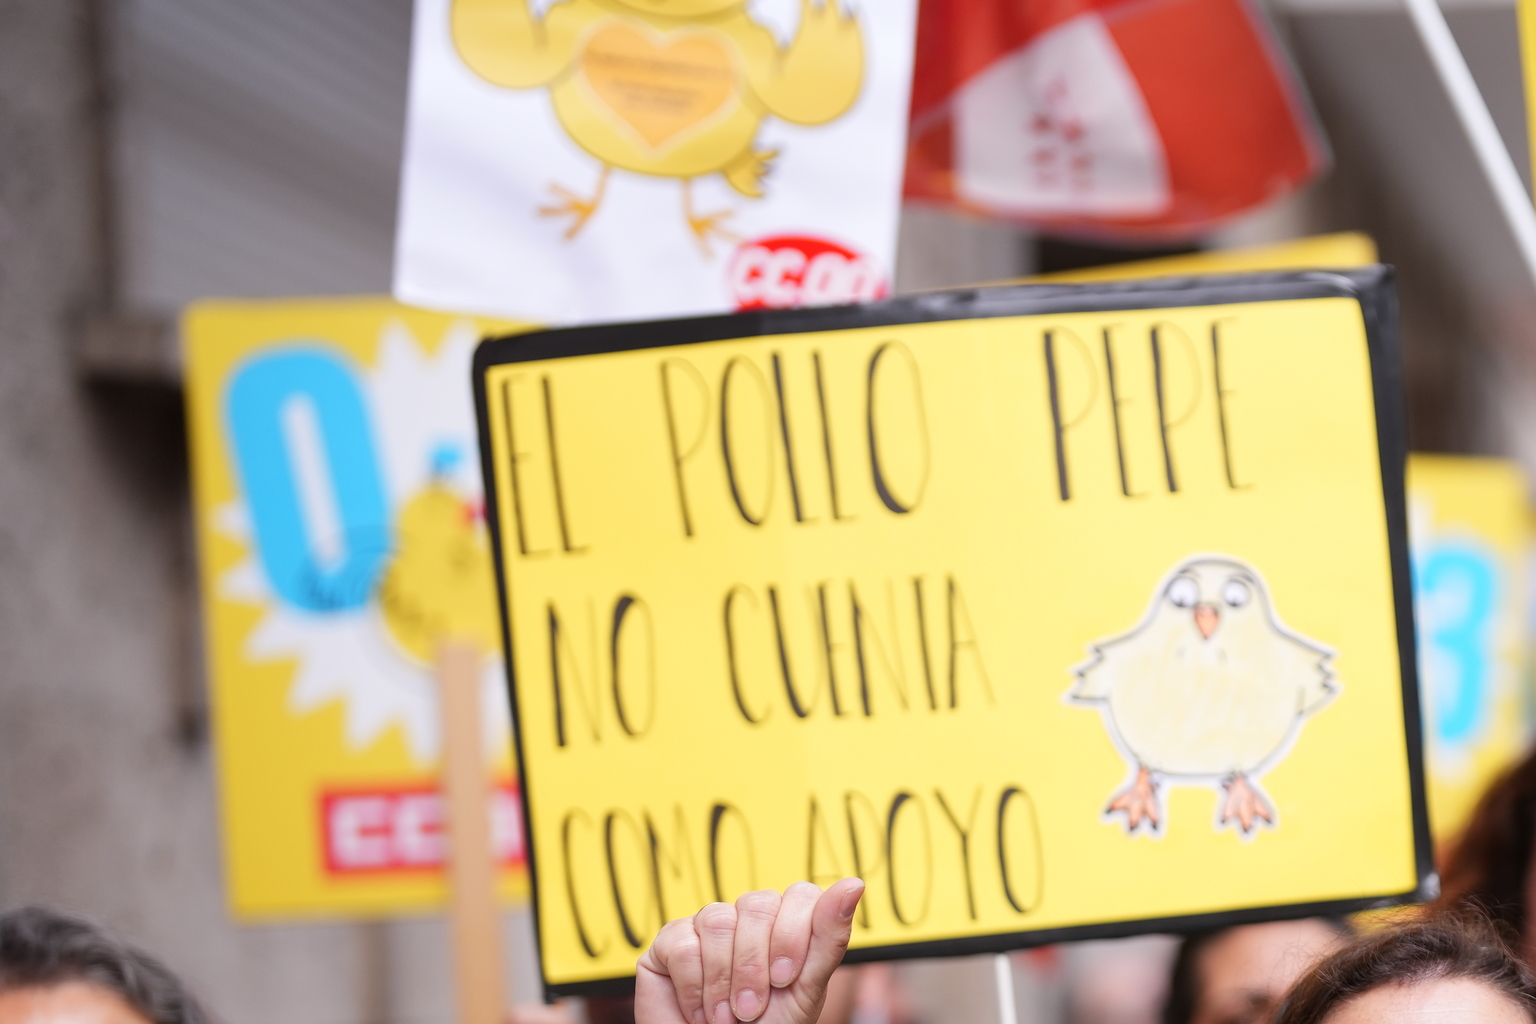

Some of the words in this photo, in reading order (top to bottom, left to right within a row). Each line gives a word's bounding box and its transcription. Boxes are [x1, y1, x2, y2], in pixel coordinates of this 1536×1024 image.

[502, 373, 590, 557] EL
[660, 339, 931, 538] POLLO
[1043, 316, 1257, 502] PEPE
[547, 590, 655, 748] NO
[723, 571, 997, 726] CUENTA
[561, 801, 757, 960] COMO
[808, 784, 1045, 930] APOYO
